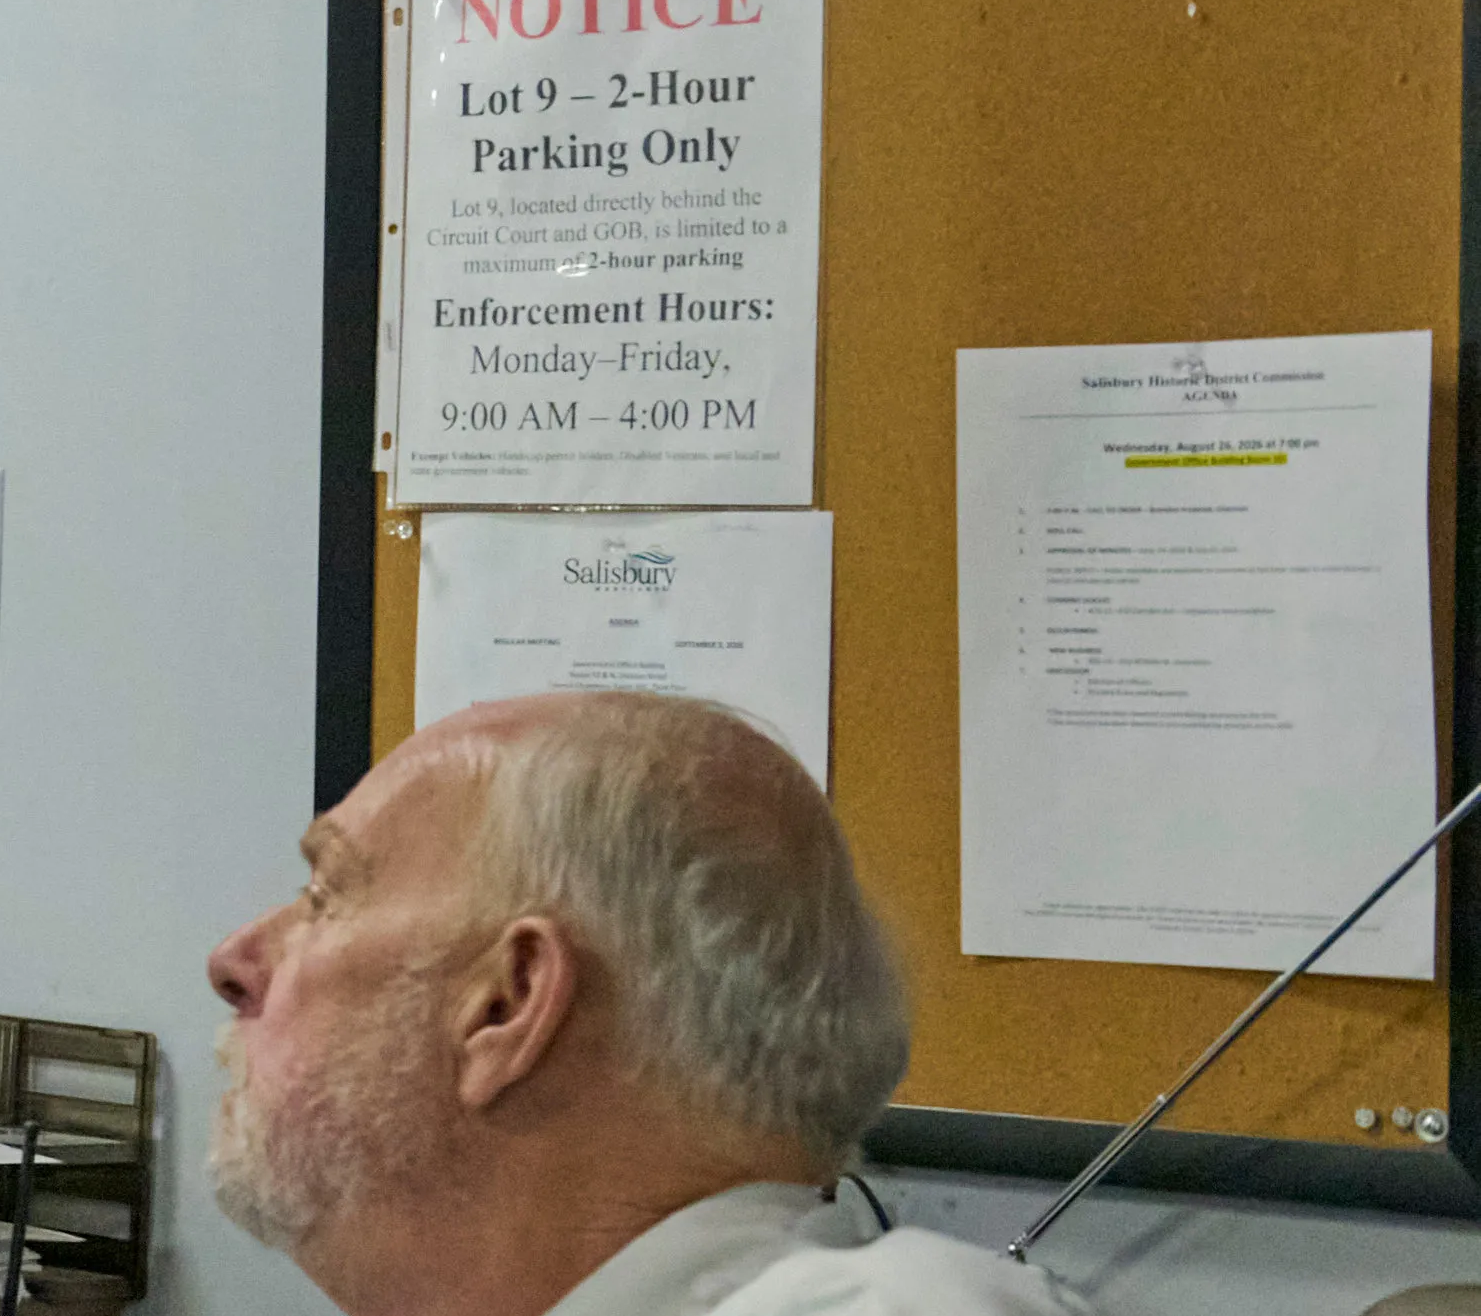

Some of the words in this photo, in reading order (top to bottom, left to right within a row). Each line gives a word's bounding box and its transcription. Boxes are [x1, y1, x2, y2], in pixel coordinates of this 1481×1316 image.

[458, 80, 521, 118] Lot
[535, 77, 557, 113] 9
[608, 69, 755, 109] 2-Hour
[472, 134, 629, 176] Parking
[642, 127, 741, 171] Only
[451, 199, 481, 219] Lot
[487, 198, 504, 220] 9,
[509, 193, 577, 216] located
[583, 191, 655, 217] directly
[661, 188, 726, 210] behind
[732, 188, 762, 207] the
[426, 226, 489, 248] Circuit
[495, 224, 548, 245] Court
[553, 223, 588, 244] and
[593, 220, 649, 243] GOB,
[655, 223, 671, 240] is
[676, 216, 745, 239] limited
[752, 218, 770, 237] to
[776, 220, 788, 236] a
[463, 255, 556, 274] maximum
[588, 250, 656, 270] 2-hour
[662, 249, 744, 271] parking
[434, 296, 645, 328] Enforcement
[659, 293, 775, 324] Hours:
[1082, 376, 1143, 389] Salisbury
[441, 401, 507, 432] 9:00
[517, 400, 578, 431] AM
[619, 398, 689, 431] 4:00
[702, 398, 757, 430] PM
[563, 557, 677, 585] Salisbury
